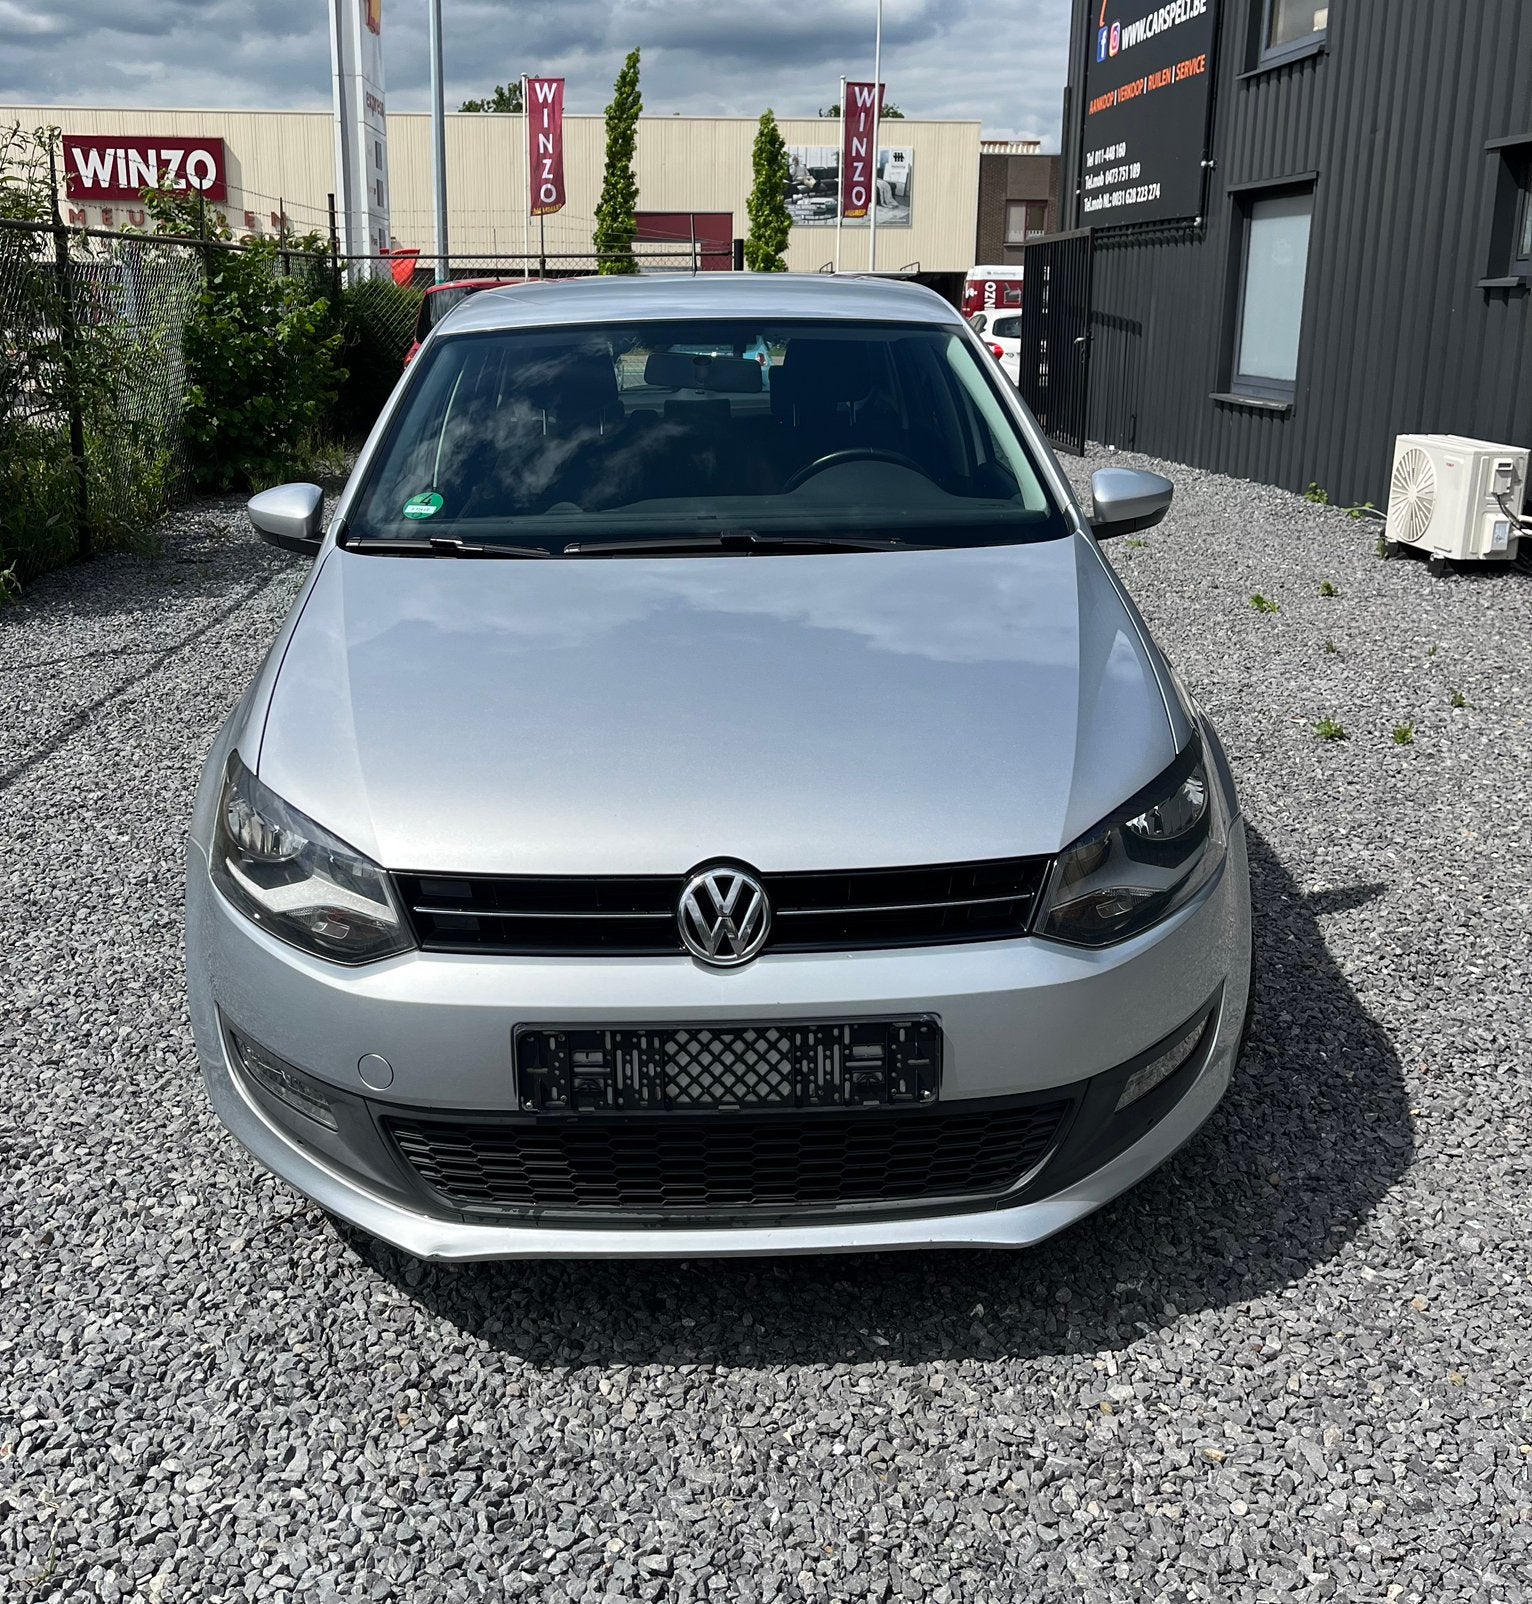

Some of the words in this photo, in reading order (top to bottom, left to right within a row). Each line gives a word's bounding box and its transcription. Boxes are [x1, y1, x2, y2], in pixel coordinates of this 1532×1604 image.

[1122, 0, 1207, 50] WWW.CARSPELT.BE
[1089, 91, 1114, 115] AANKOOP
[1118, 78, 1143, 103] VERKOOP
[1148, 67, 1171, 91] RUILEN
[1176, 54, 1205, 80] SERVICE
[71, 147, 217, 191] WINZO
[535, 82, 557, 203] WINZO
[851, 86, 876, 206] WINZO
